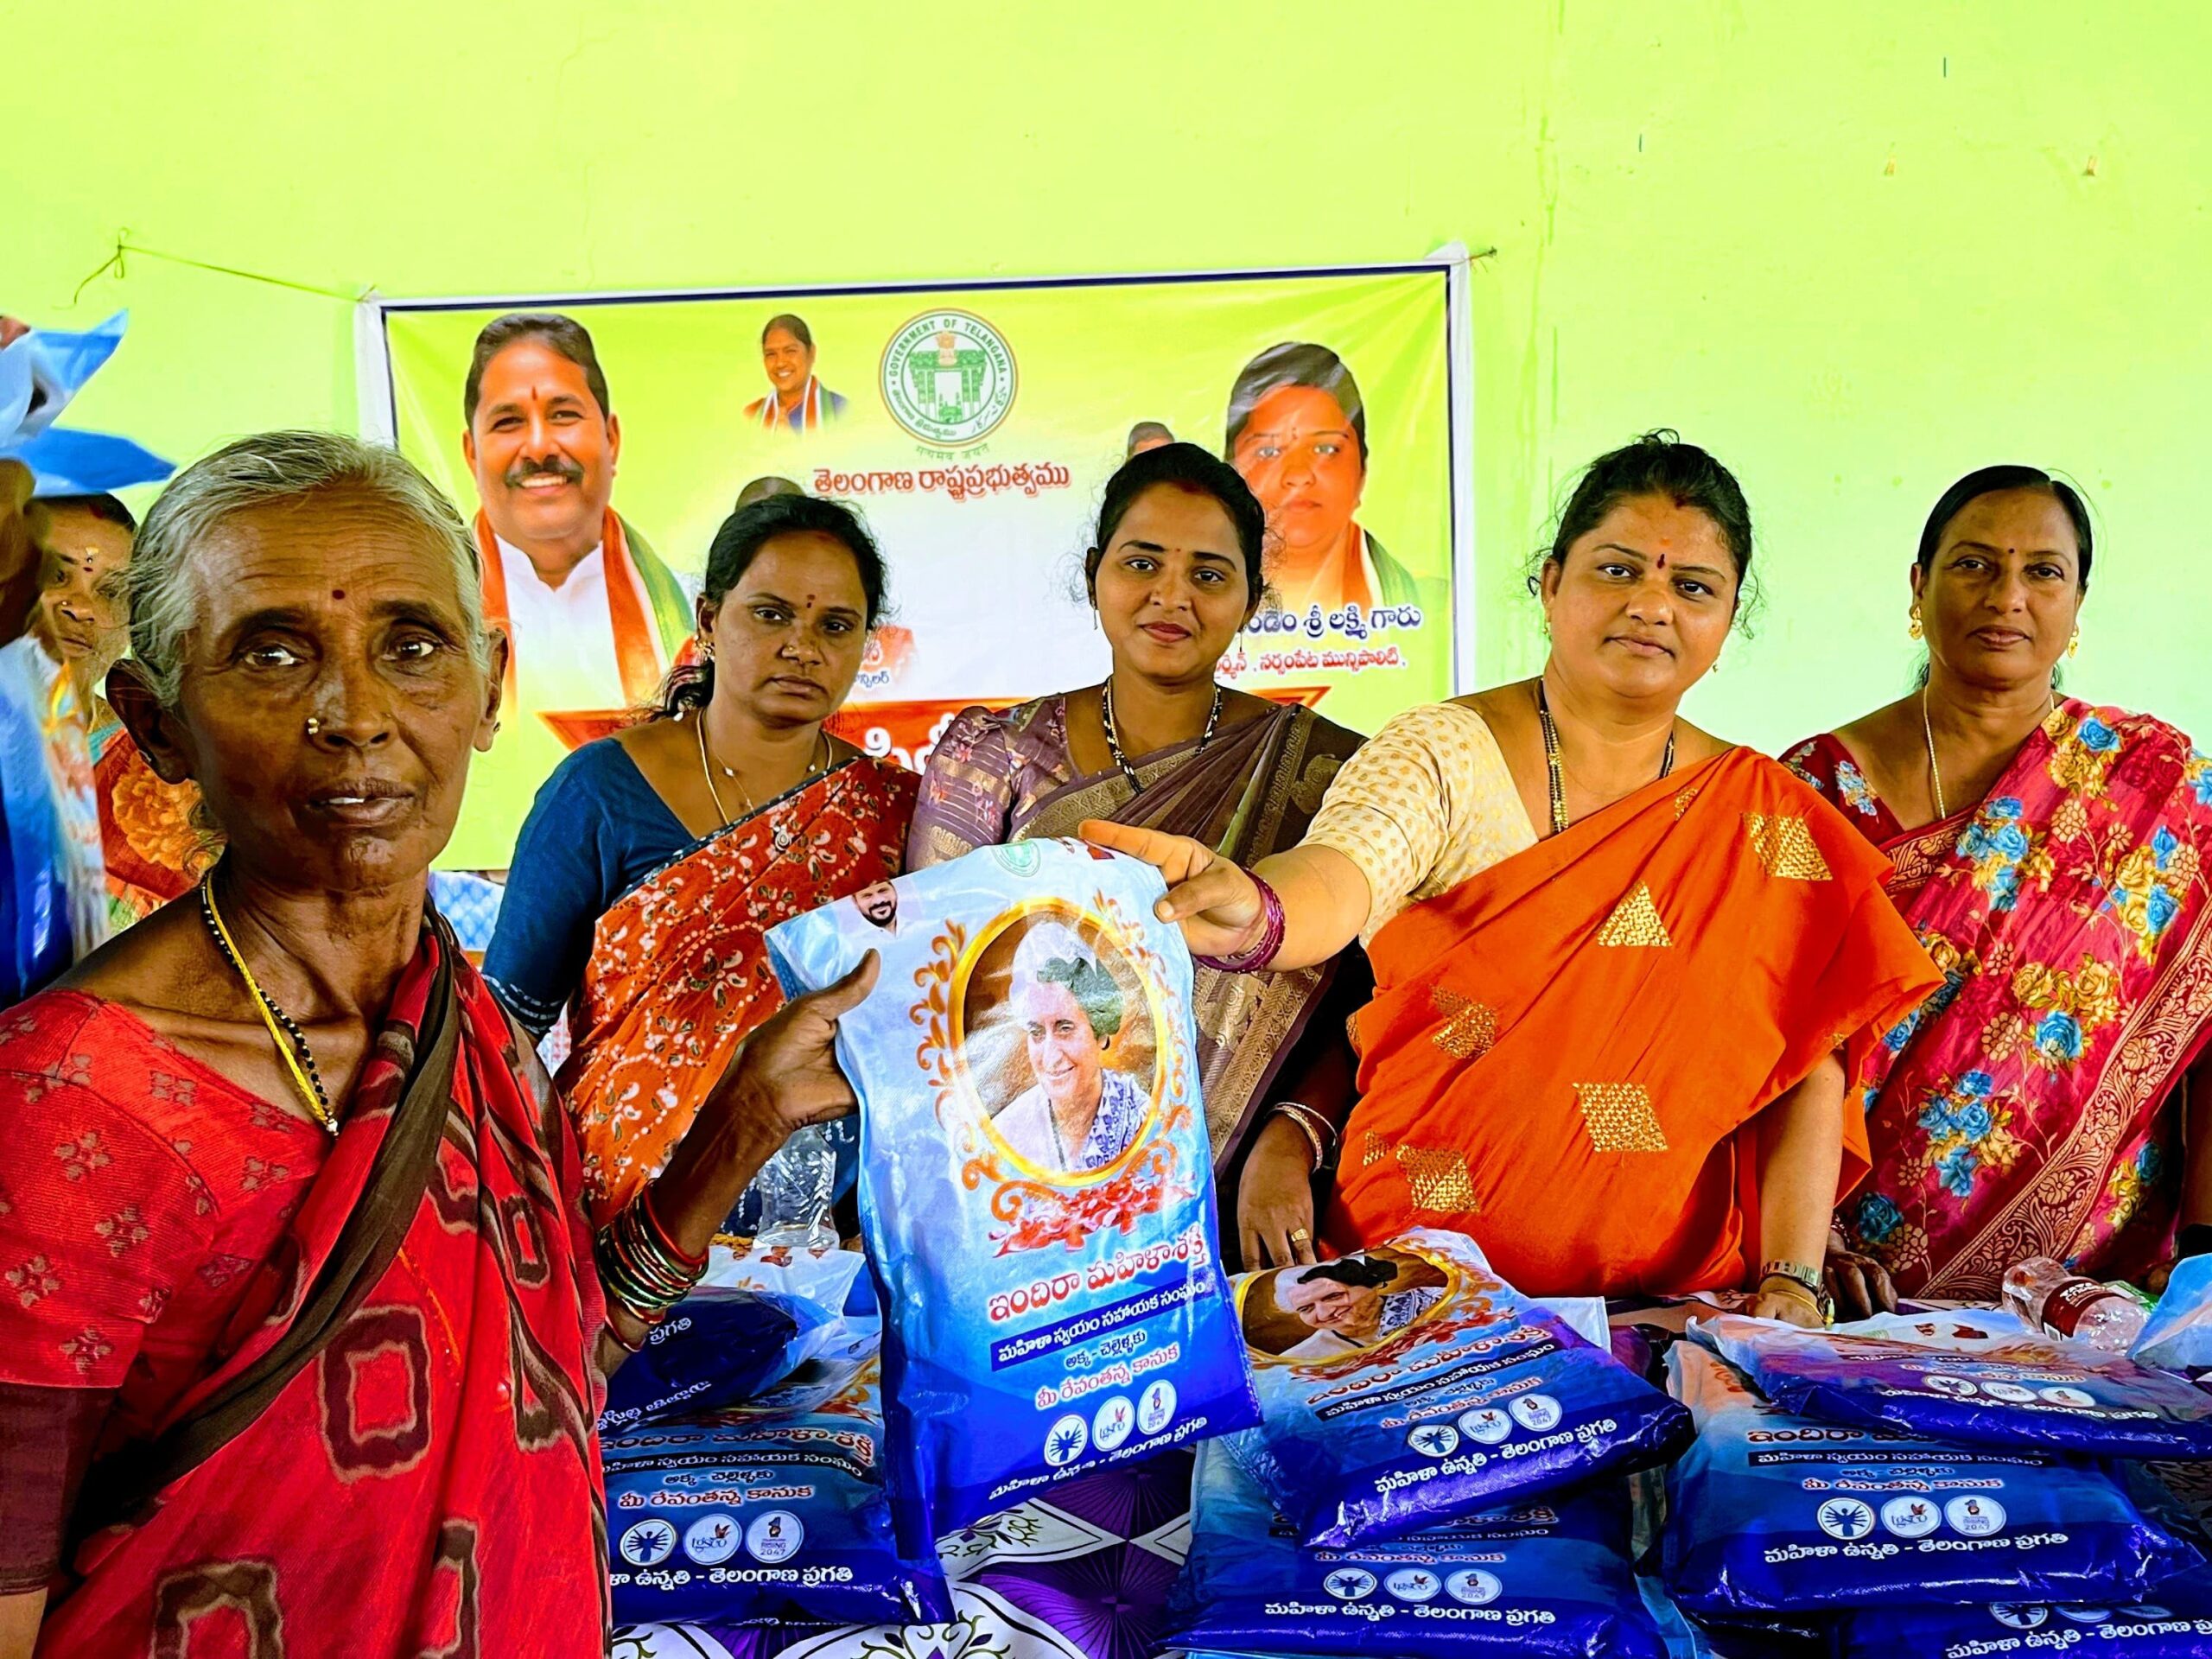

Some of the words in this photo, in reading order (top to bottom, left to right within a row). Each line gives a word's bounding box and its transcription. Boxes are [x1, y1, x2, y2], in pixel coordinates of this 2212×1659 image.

[889, 321, 935, 377] GOVERNMENT
[944, 319, 957, 328] OF
[964, 322, 1007, 373] TELANGANA
[813, 468, 913, 493] తెలంగాణ
[1247, 610, 1297, 633] ండెం
[1304, 605, 1325, 638] శ్రీ
[1329, 605, 1368, 639] లక్ష్మి
[1371, 607, 1421, 628] గారు
[988, 1273, 1080, 1320] ఇందిరా
[650, 1318, 692, 1344] ప్రగతి
[998, 1335, 1052, 1363] మహిళా
[1053, 1319, 1099, 1344] స్వయం
[1102, 1297, 1159, 1326] సహాయక
[1066, 1351, 1091, 1367] అక్క
[1038, 1389, 1058, 1408] మీ
[1061, 1366, 1131, 1402] రేవంతన్న
[1133, 1344, 1179, 1375] కానుక
[1326, 1395, 1381, 1416] మహిళా
[1382, 1383, 1434, 1402] స్వయం
[1748, 1428, 1864, 1444] ఇందిరా
[657, 1455, 718, 1468] స్వయం
[721, 1453, 801, 1463] సహాయక
[804, 1453, 863, 1477] సంఘం
[988, 1474, 1050, 1500] మహిళా
[1109, 1433, 1172, 1463] తెలంగాణ
[1173, 1417, 1208, 1442] ప్రగతి
[1374, 1464, 1438, 1493] మహిళా
[1440, 1452, 1487, 1475] ఉన్నతి
[1499, 1430, 1573, 1460] తెలంగాణ
[1579, 1417, 1618, 1444] ప్రగతి
[1758, 1452, 1823, 1463] మహిళా
[1827, 1452, 1889, 1464] స్వయం
[664, 1472, 698, 1486] అక్క
[619, 1492, 645, 1507] మీ
[650, 1489, 741, 1506] రేవంతన్న
[747, 1486, 812, 1499] కానుక
[1764, 1544, 1838, 1563] మహిళా
[1842, 1541, 1899, 1560] ఉన్నతి
[1916, 1535, 2011, 1554] తెలంగాణ
[2015, 1531, 2069, 1551] ప్రగతి
[635, 1568, 691, 1590] ఉన్నతి
[709, 1568, 798, 1586] తెలంగాణ
[803, 1567, 854, 1588] ప్రగతి
[1264, 1600, 1337, 1616] మహిళా
[1341, 1601, 1395, 1623] ఉన్నతి
[1414, 1605, 1501, 1623] తెలంగాణ
[1506, 1608, 1556, 1626] ప్రగతి
[1945, 1637, 2020, 1659] మహిళా
[2024, 1629, 2082, 1649] ఉన్నతి
[2096, 1619, 2191, 1639] తెలంగాణ
